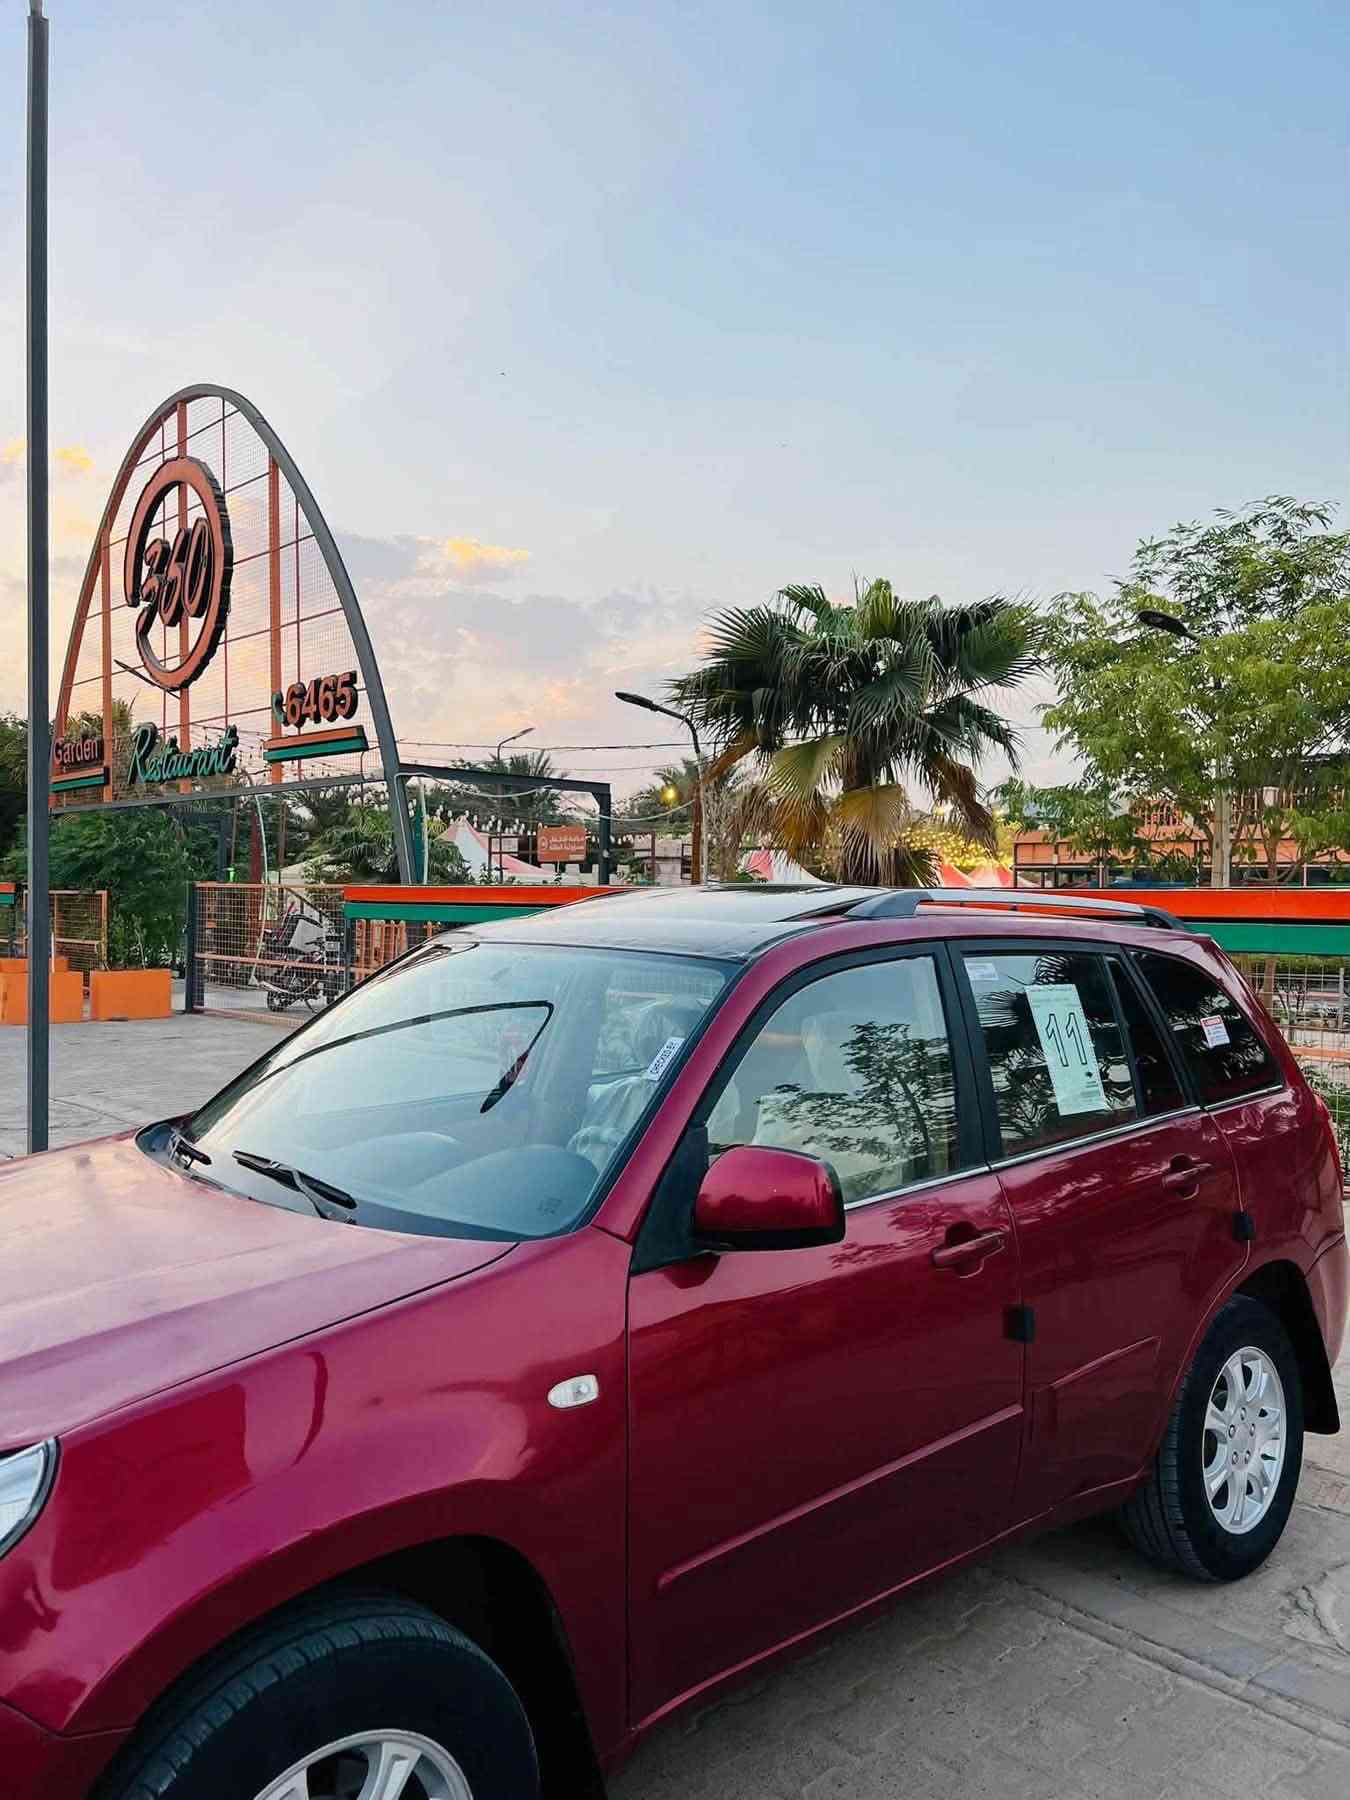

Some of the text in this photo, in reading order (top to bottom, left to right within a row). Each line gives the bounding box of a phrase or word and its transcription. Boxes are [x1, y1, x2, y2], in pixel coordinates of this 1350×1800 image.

[140, 516, 213, 627] 360
[286, 670, 358, 728] 6465
[54, 737, 100, 764] Garden
[127, 722, 239, 785] Restaurant
